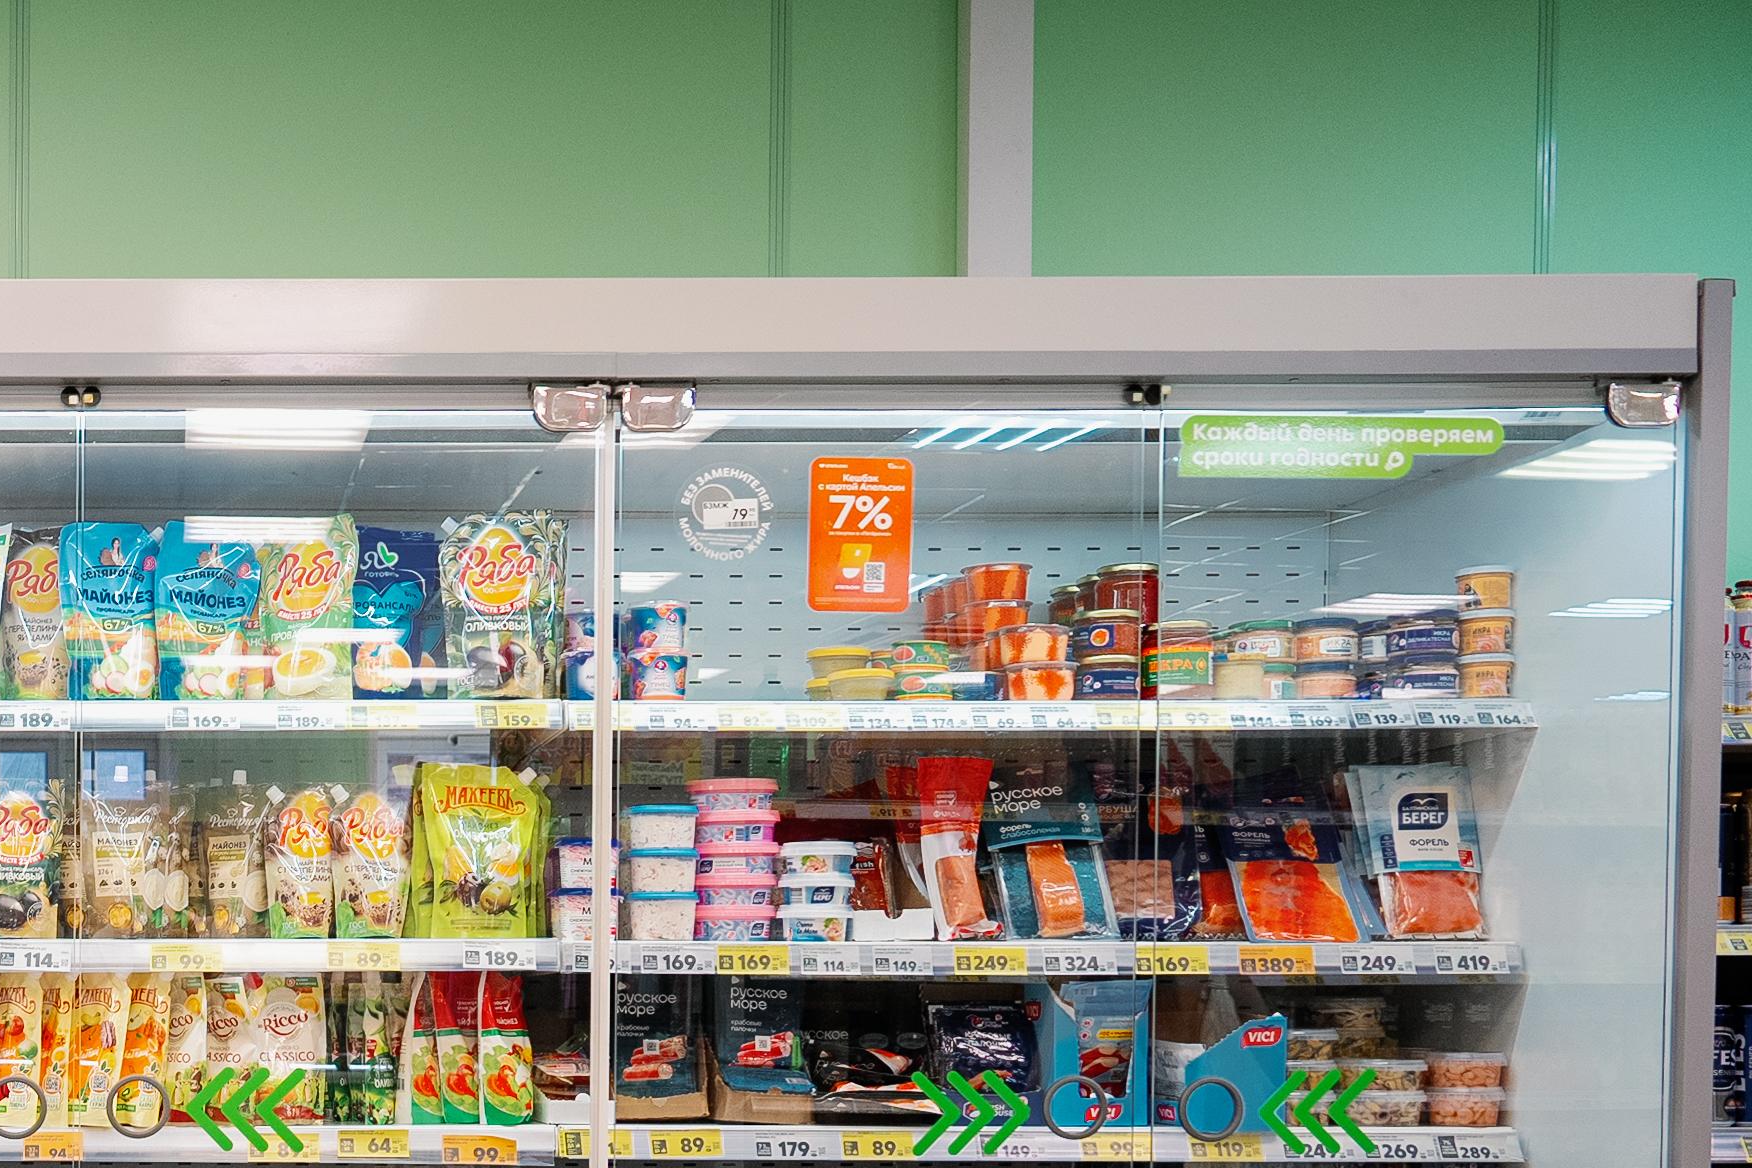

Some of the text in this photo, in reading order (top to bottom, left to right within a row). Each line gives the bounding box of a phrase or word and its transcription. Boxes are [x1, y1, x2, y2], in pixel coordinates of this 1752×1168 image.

[1192, 423, 1494, 446] Каждый день проверяем
[1192, 450, 1380, 470] сроки годности
[842, 473, 879, 483] Кешбэк
[679, 467, 773, 512] БЕЗ ЗАМЕНИТЕЛЕЙ
[825, 483, 858, 494] картой
[859, 481, 906, 492] Апельсин
[828, 495, 893, 530] 7%
[677, 516, 772, 561] МОЛОЧНОГО ЖИРА
[458, 543, 536, 588] Ряба
[81, 567, 145, 584] селяночка
[176, 567, 238, 589] селяночка
[274, 550, 339, 602] Ряба
[78, 588, 154, 605] МАЙОНЕЗ
[170, 588, 247, 609] МАЙОНЕЗ
[103, 618, 133, 631] 67%
[465, 620, 530, 633] ОЛИВКОВЫЙ
[19, 713, 53, 727] 189
[194, 715, 222, 727] 169
[503, 714, 531, 726] 159
[991, 785, 1063, 805] русское
[994, 797, 1040, 816] море
[1401, 811, 1445, 825] БЕРЕГ
[1232, 831, 1270, 839] ФОРЕЛЬ
[1409, 837, 1450, 848] ФОРЕЛЬ
[484, 951, 518, 966] 189
[662, 954, 697, 969] 169
[738, 954, 771, 970] 169
[973, 956, 1008, 971] 249
[1064, 956, 1098, 972] 324
[1259, 957, 1294, 972] 389
[1360, 955, 1396, 971] 249
[1456, 955, 1490, 971] 419
[730, 986, 788, 1000] русское
[730, 999, 768, 1012] море
[264, 1011, 308, 1035] Ricco
[1248, 1030, 1276, 1043] VICI
[259, 1050, 315, 1062] CLASSICO
[367, 1138, 392, 1152] 64
[680, 1137, 705, 1153] 89
[778, 1142, 810, 1157] 179
[871, 1141, 896, 1156] 89
[1002, 1144, 1030, 1157] 149
[1213, 1143, 1244, 1157] 119
[1382, 1144, 1418, 1158] 269
[1459, 1146, 1491, 1159] 289
[473, 1147, 498, 1163] 99
